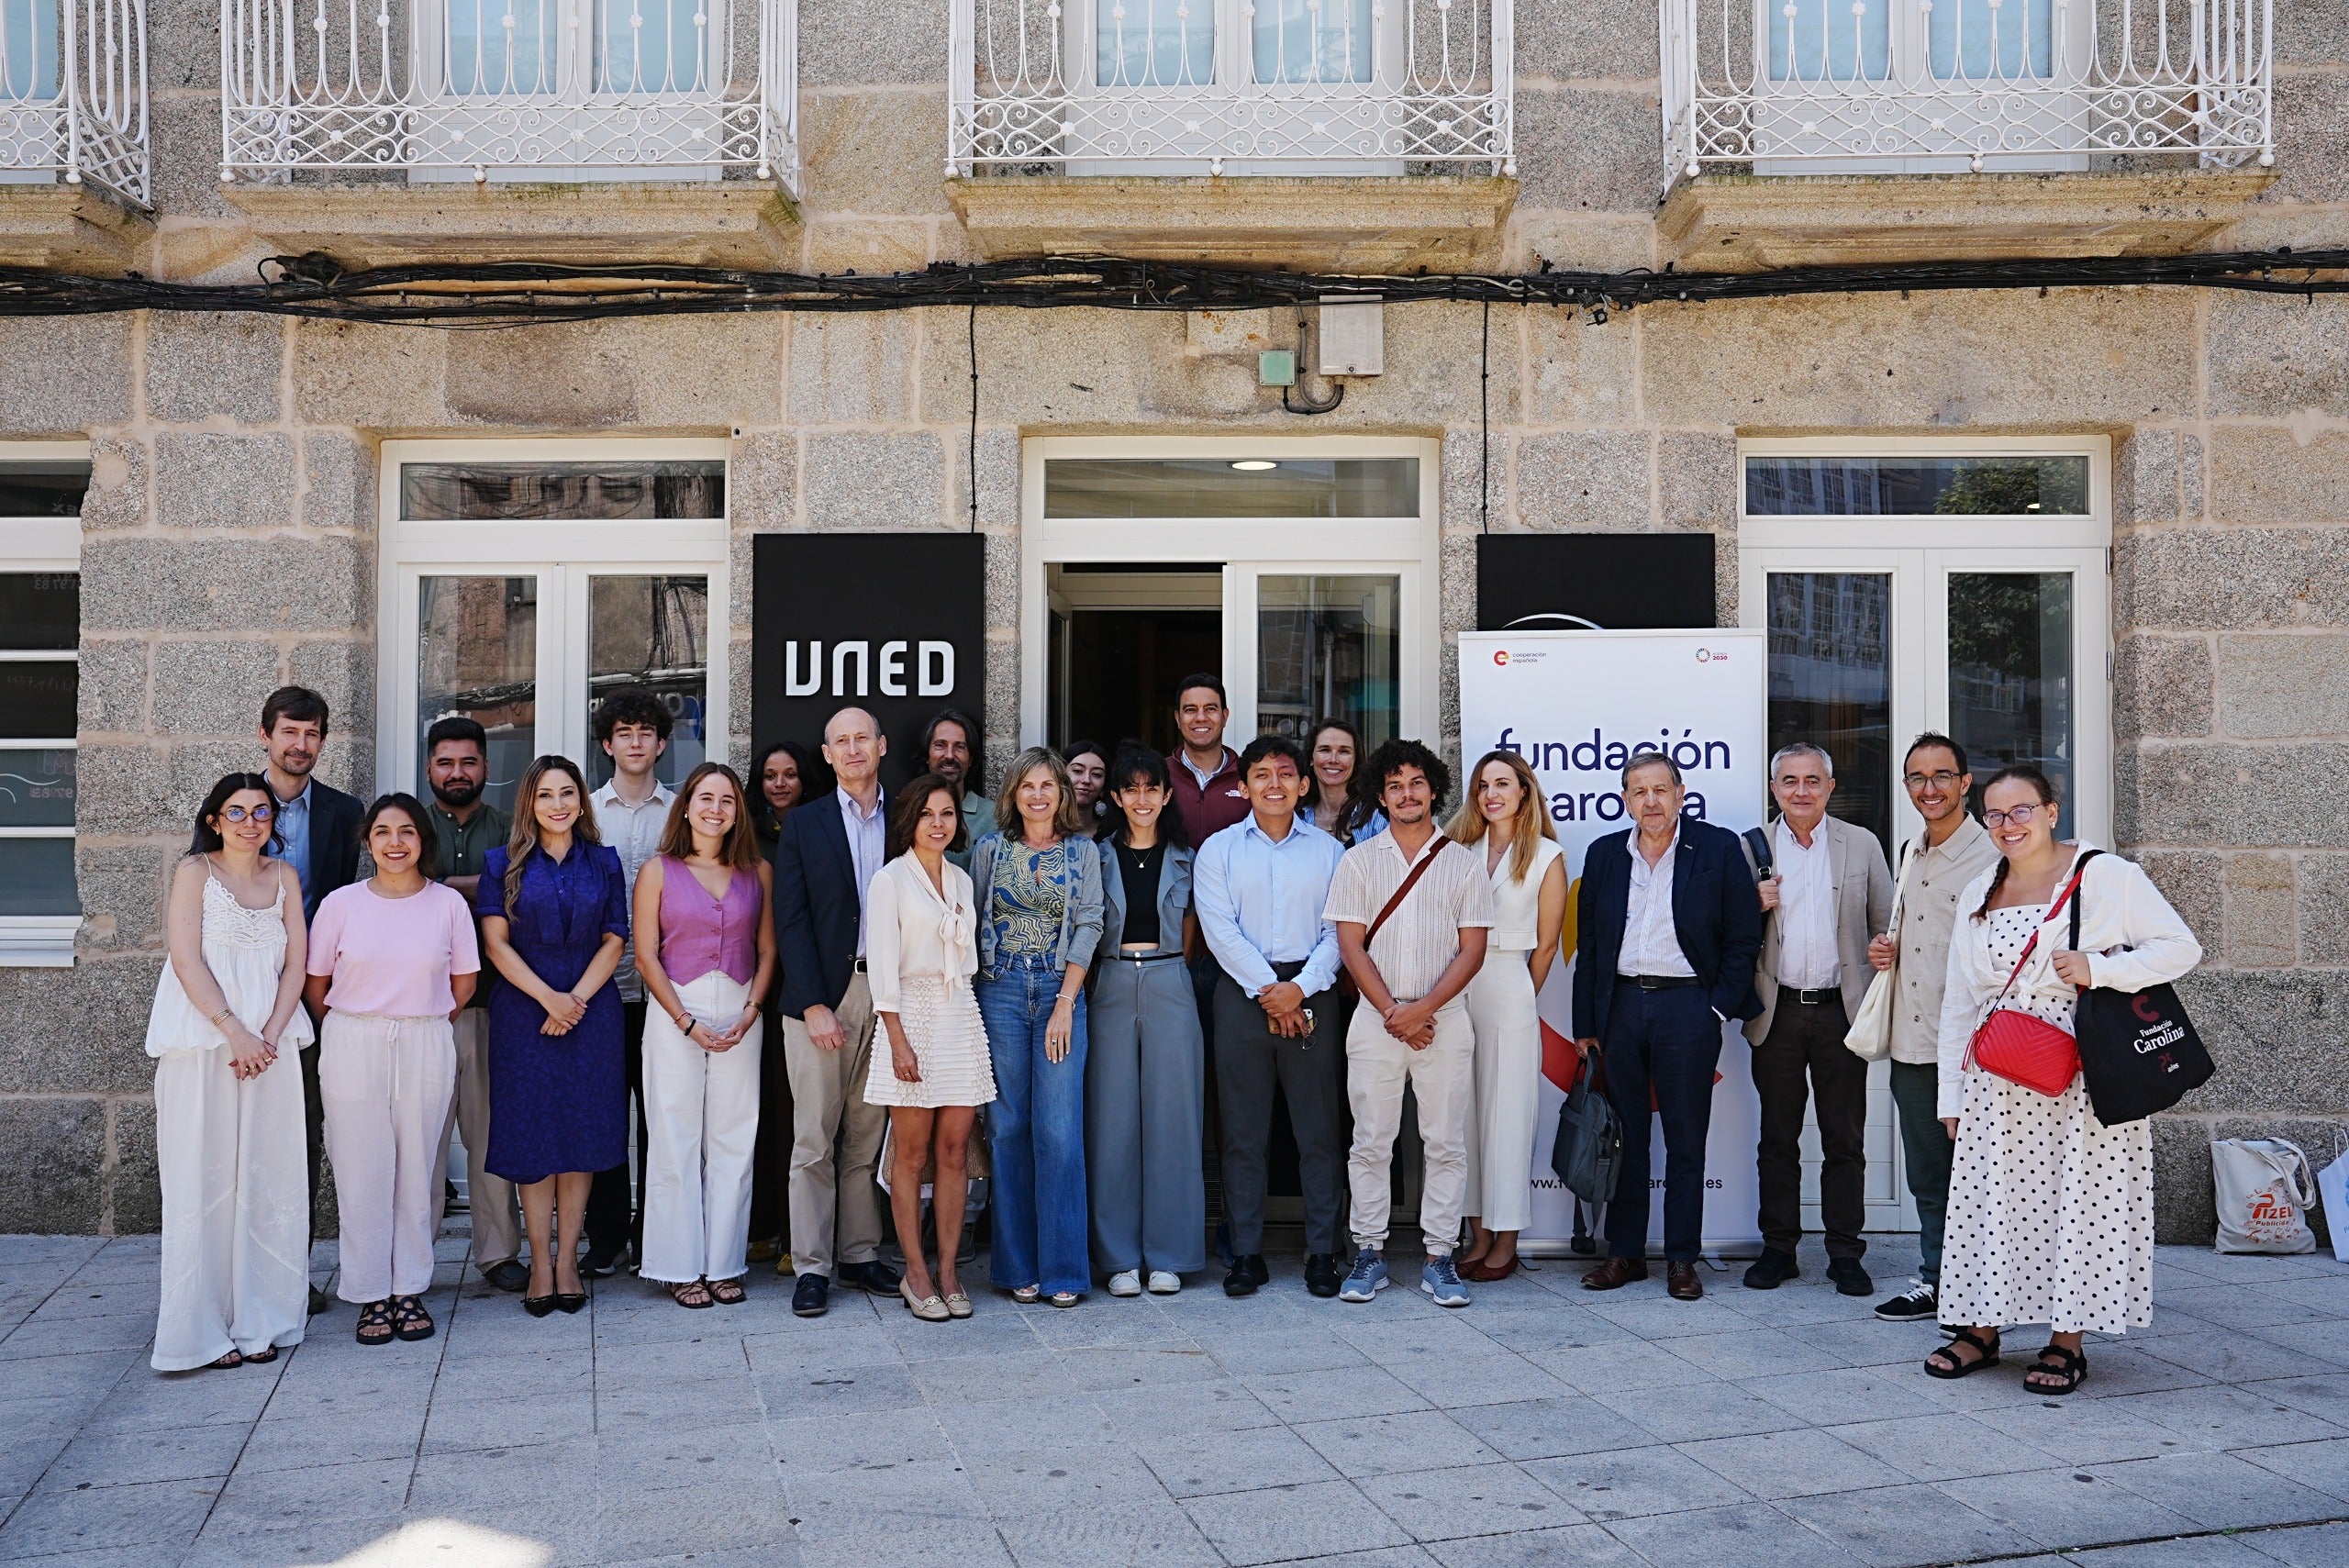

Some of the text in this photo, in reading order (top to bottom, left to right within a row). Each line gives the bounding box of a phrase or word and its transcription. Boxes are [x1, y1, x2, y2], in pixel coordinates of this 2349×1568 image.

[785, 640, 954, 696] UNED
[2133, 1026, 2185, 1054] Carolina
[2139, 1019, 2173, 1037] Fundación
